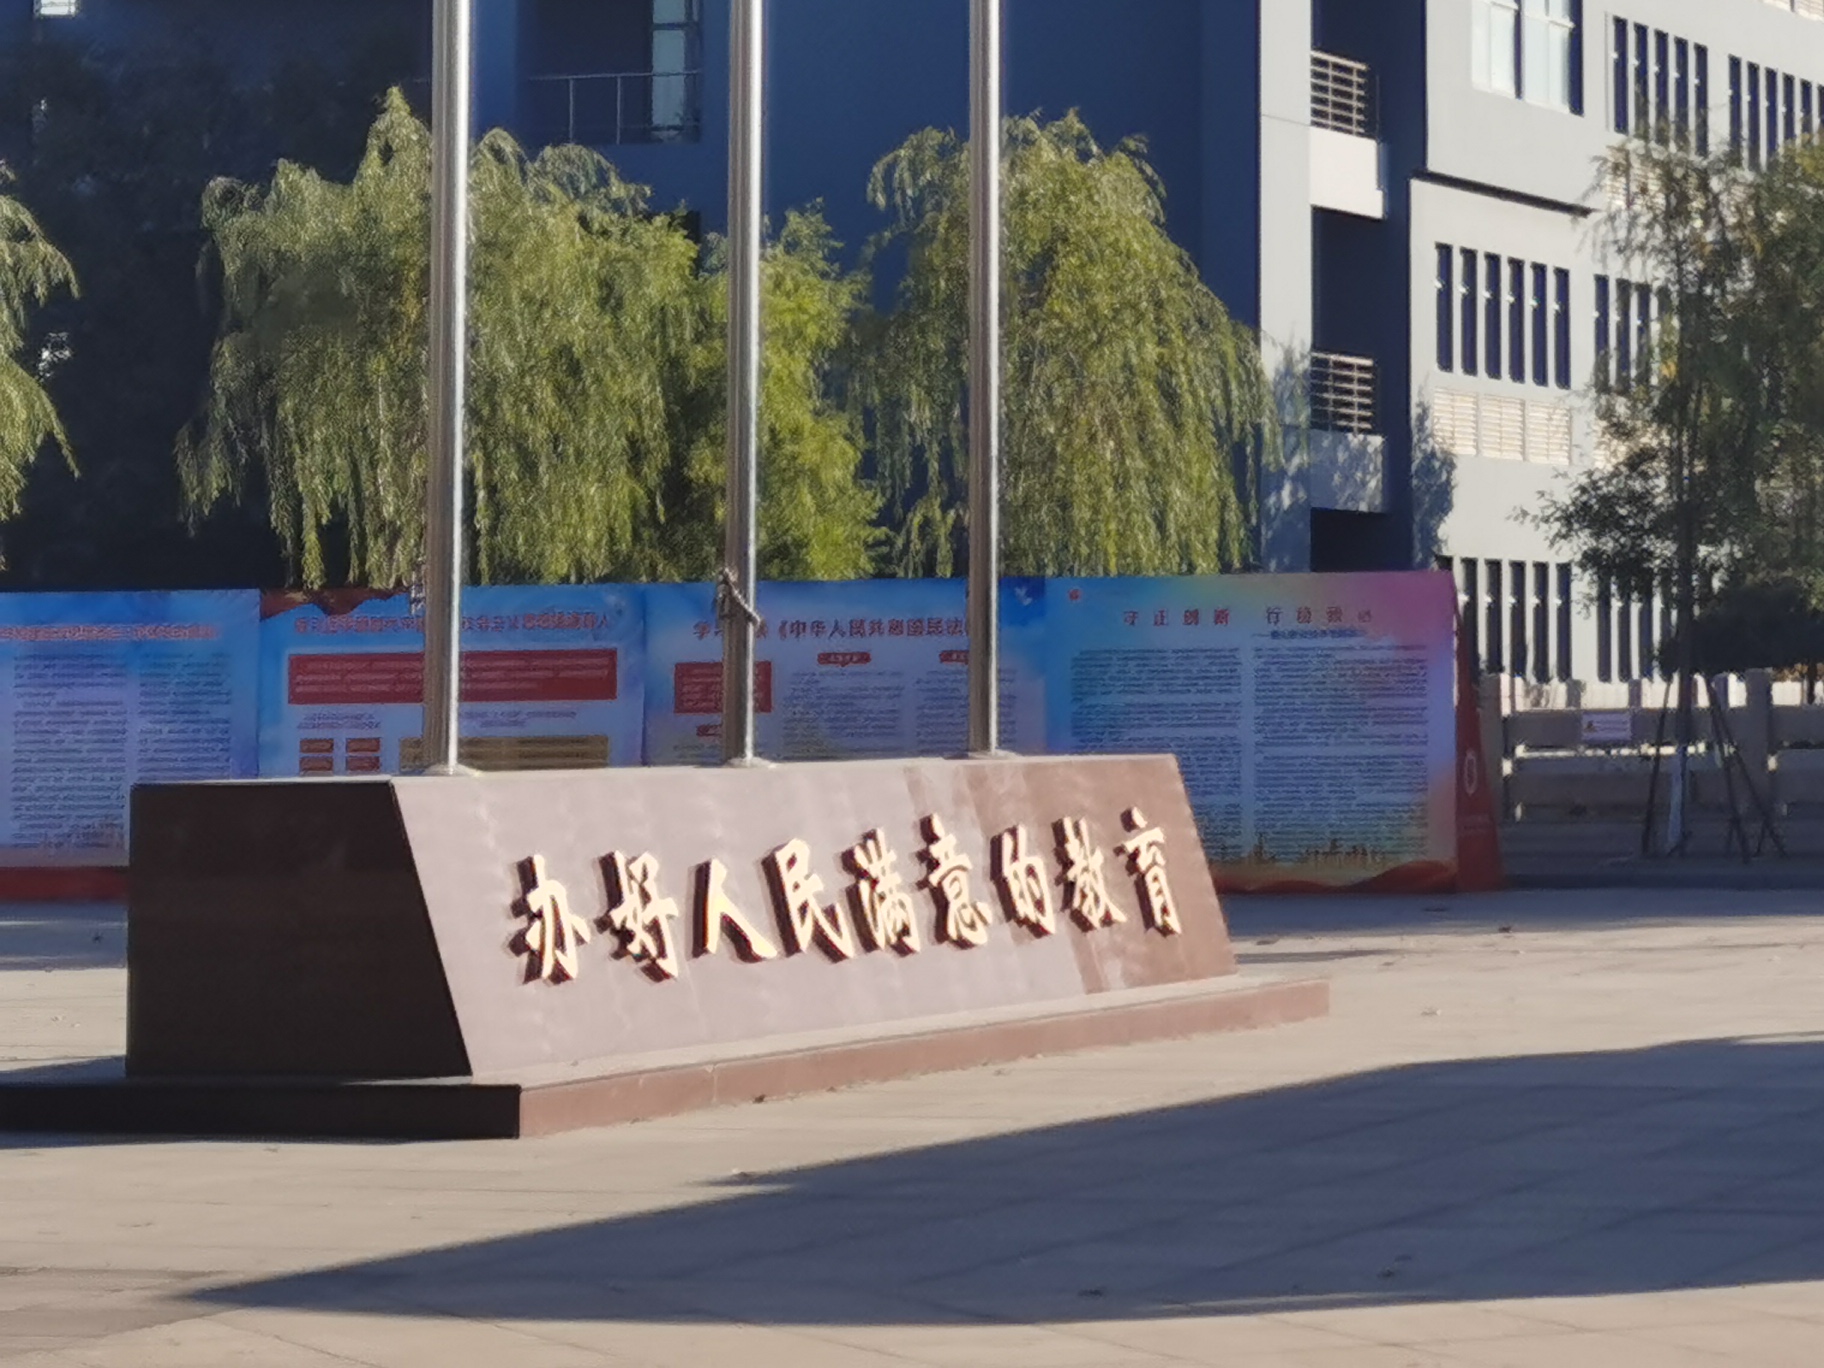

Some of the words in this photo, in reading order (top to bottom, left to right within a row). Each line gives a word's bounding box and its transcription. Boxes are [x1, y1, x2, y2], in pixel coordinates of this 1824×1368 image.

[507, 807, 1182, 984] 办好人民满意的教育
